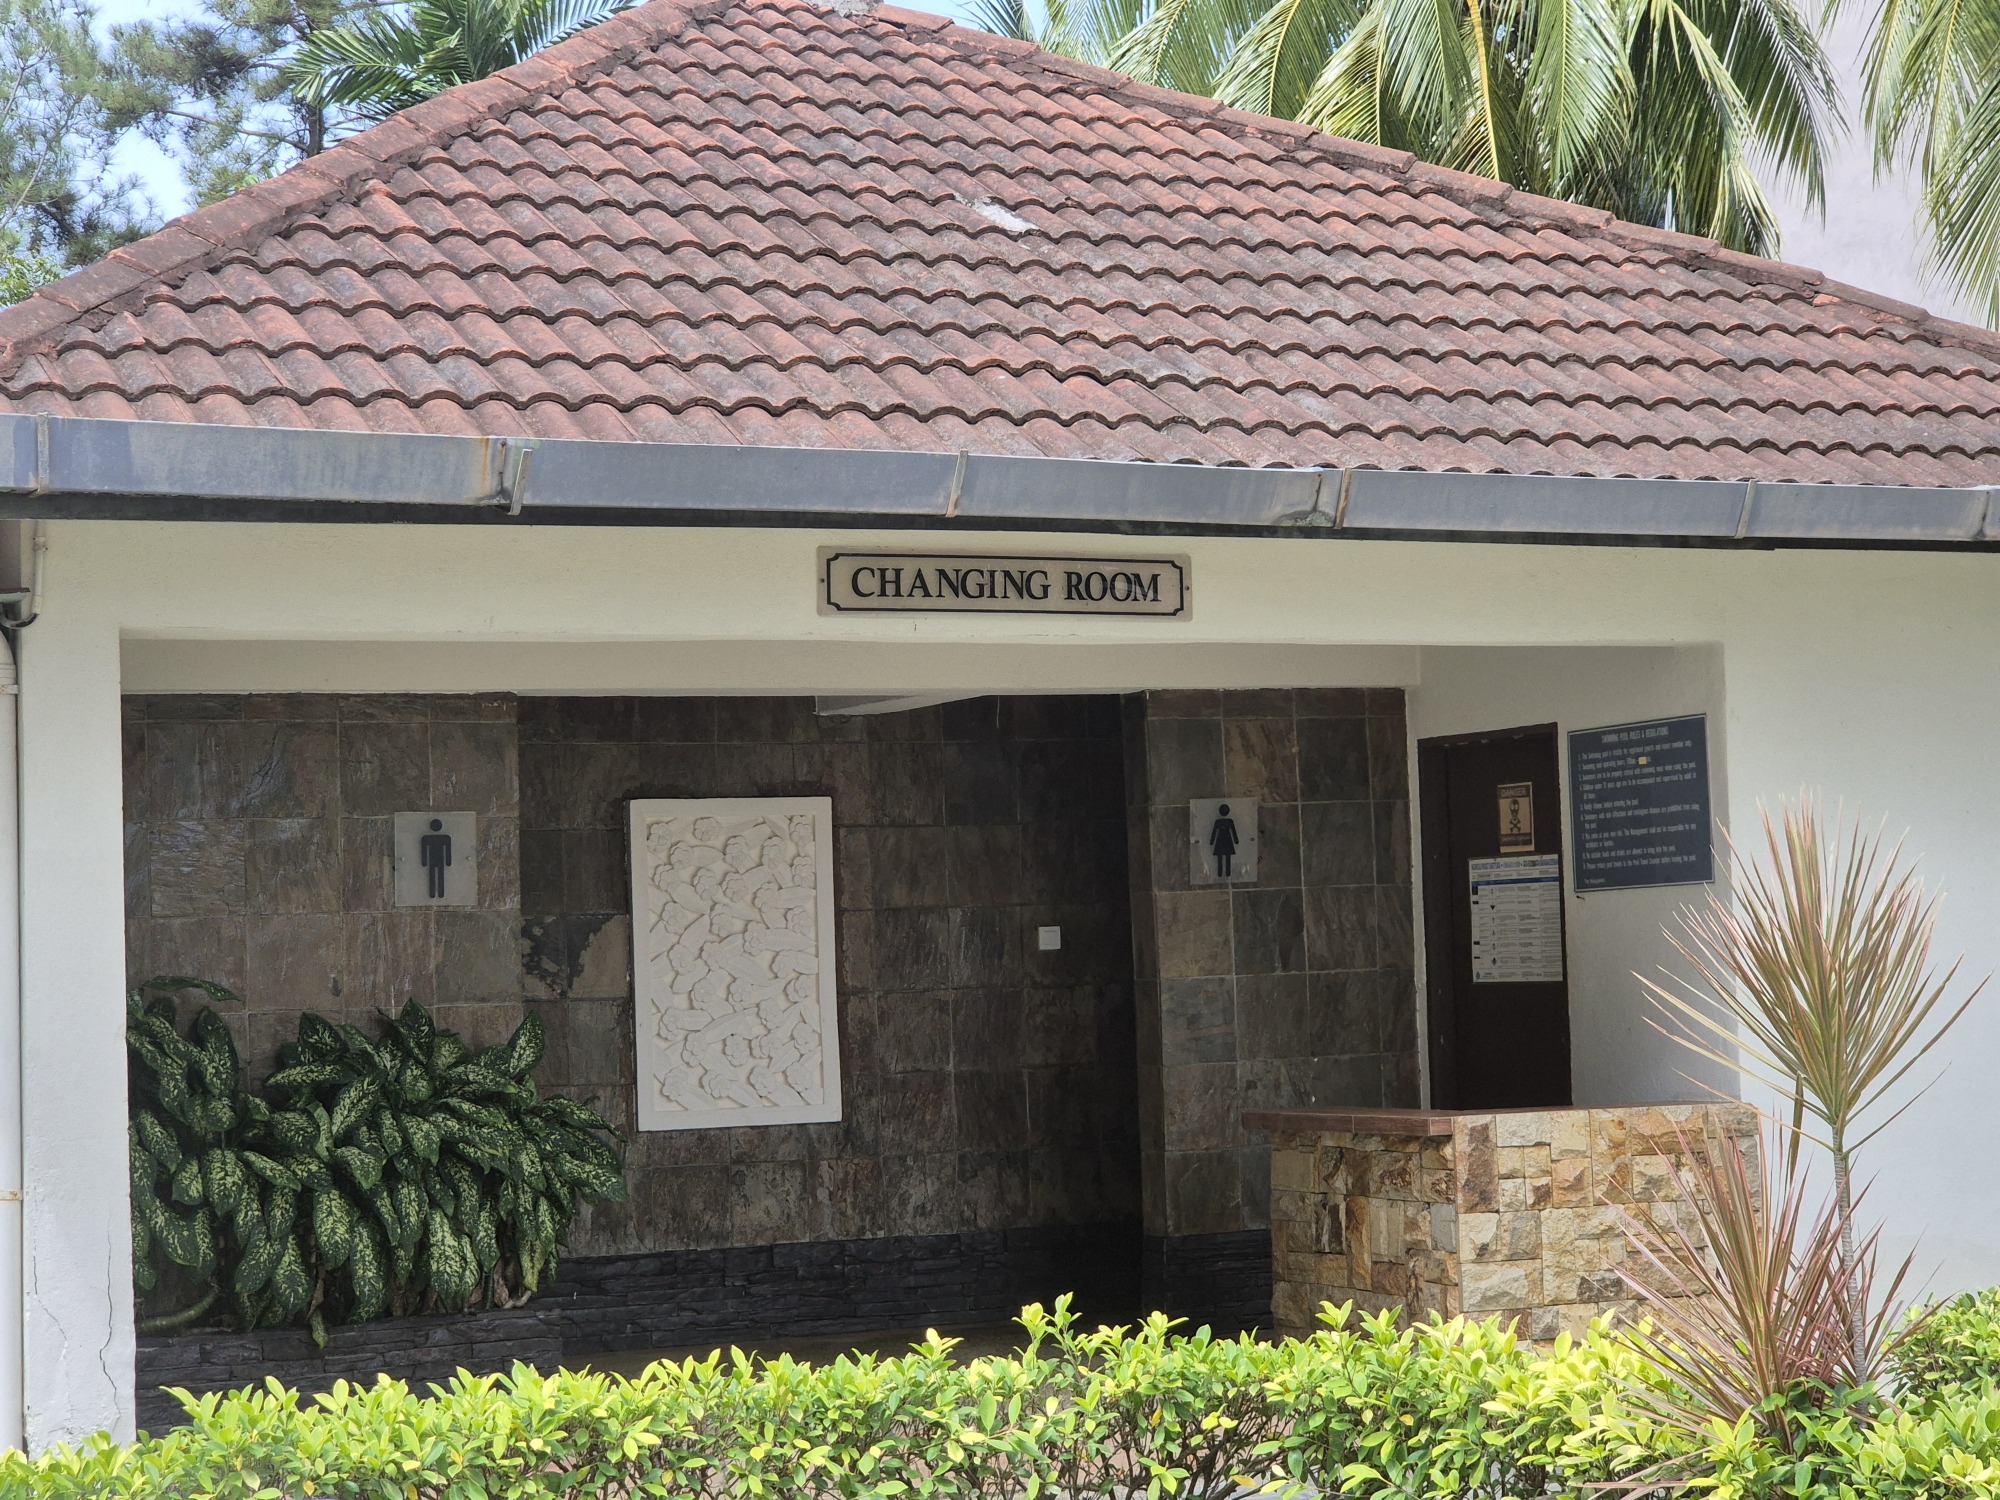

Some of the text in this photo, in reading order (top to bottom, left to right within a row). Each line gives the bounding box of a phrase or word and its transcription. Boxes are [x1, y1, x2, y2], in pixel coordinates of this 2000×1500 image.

[851, 566, 1162, 602] CHANGING ROOM
[1501, 787, 1526, 797] DANGER
